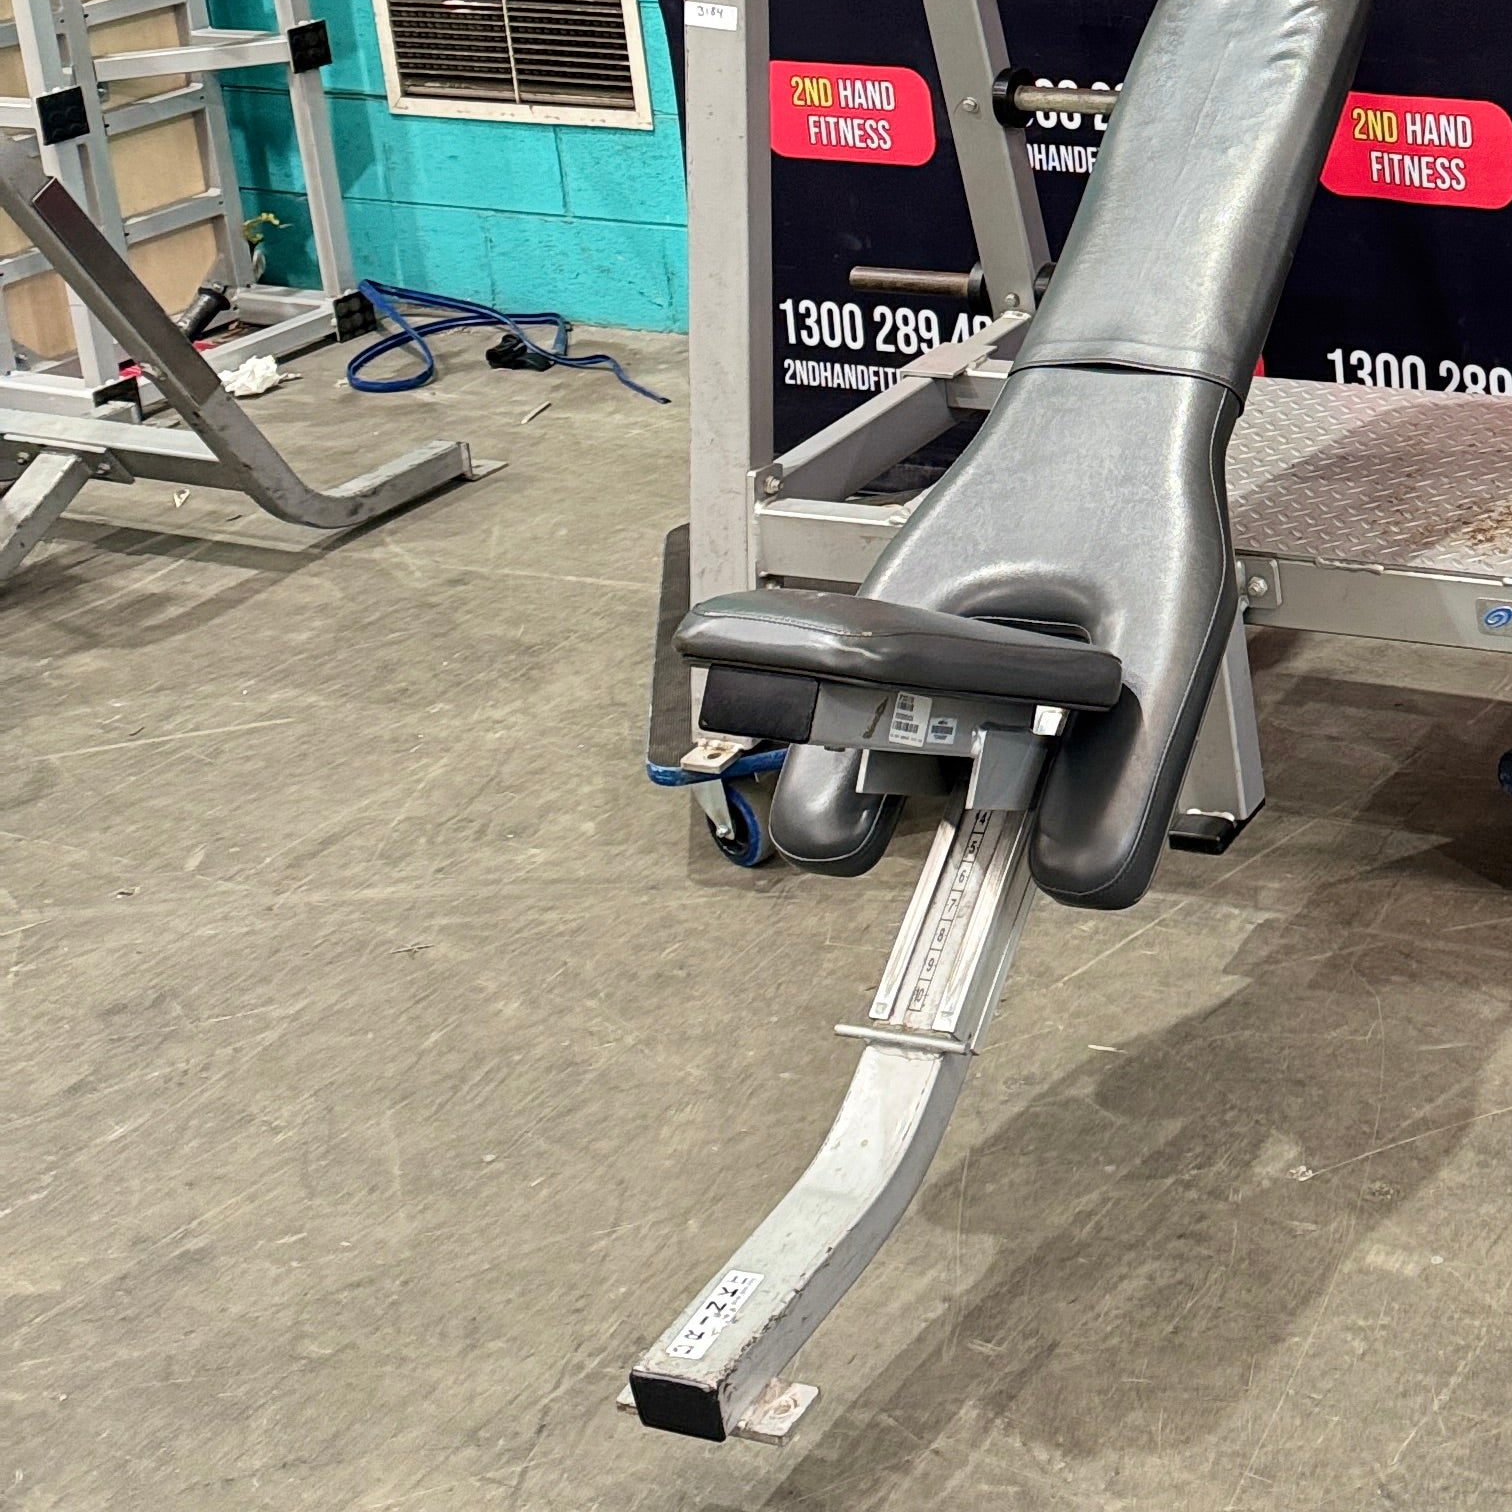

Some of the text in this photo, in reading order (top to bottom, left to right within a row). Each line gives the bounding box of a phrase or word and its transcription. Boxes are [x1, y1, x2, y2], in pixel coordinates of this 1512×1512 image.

[790, 76, 896, 111] 2ND HAND
[808, 115, 892, 150] FITNESS
[1352, 108, 1473, 148] 2ND HAND
[1370, 151, 1466, 191] FITNESS
[779, 298, 865, 350] 1300
[872, 305, 940, 355] 289
